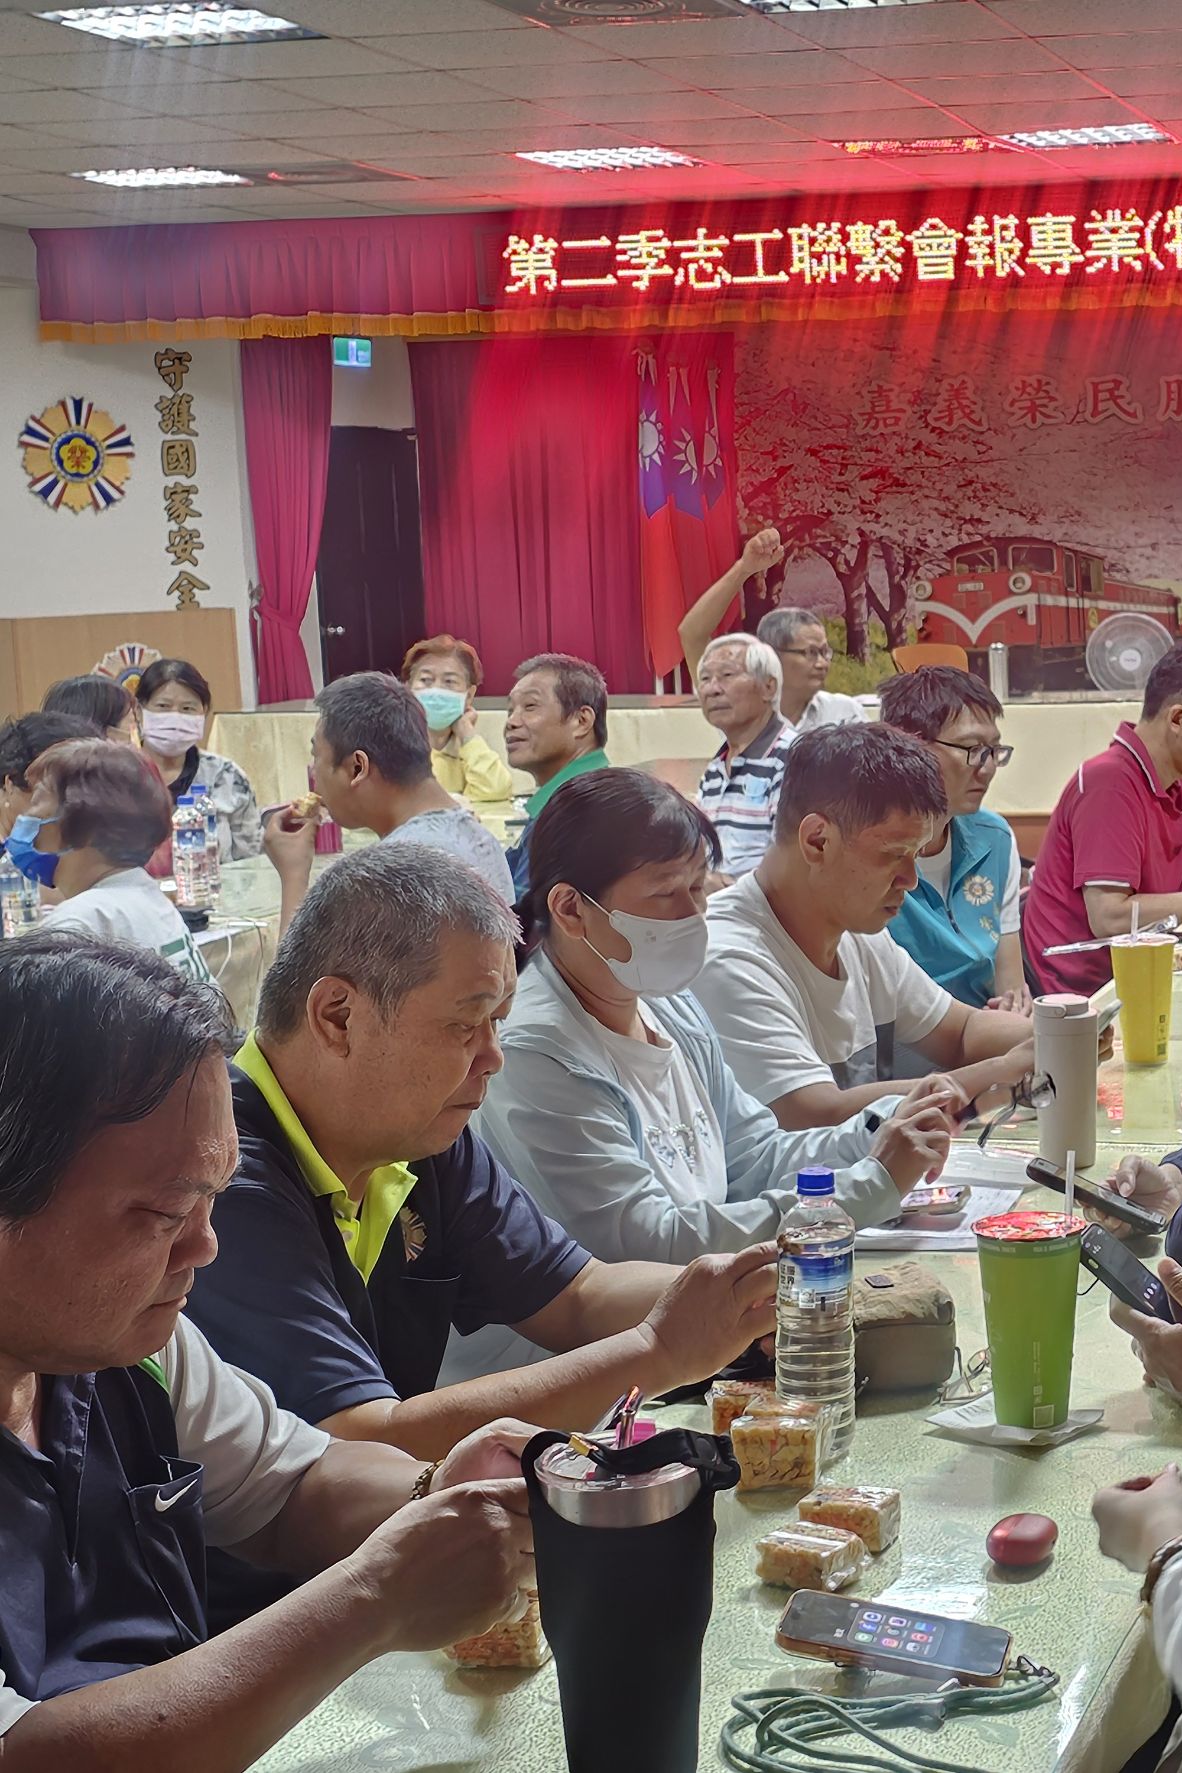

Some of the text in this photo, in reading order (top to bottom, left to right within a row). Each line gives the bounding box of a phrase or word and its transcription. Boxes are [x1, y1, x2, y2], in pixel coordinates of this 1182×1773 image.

[154, 348, 211, 610] 守護國家安全
